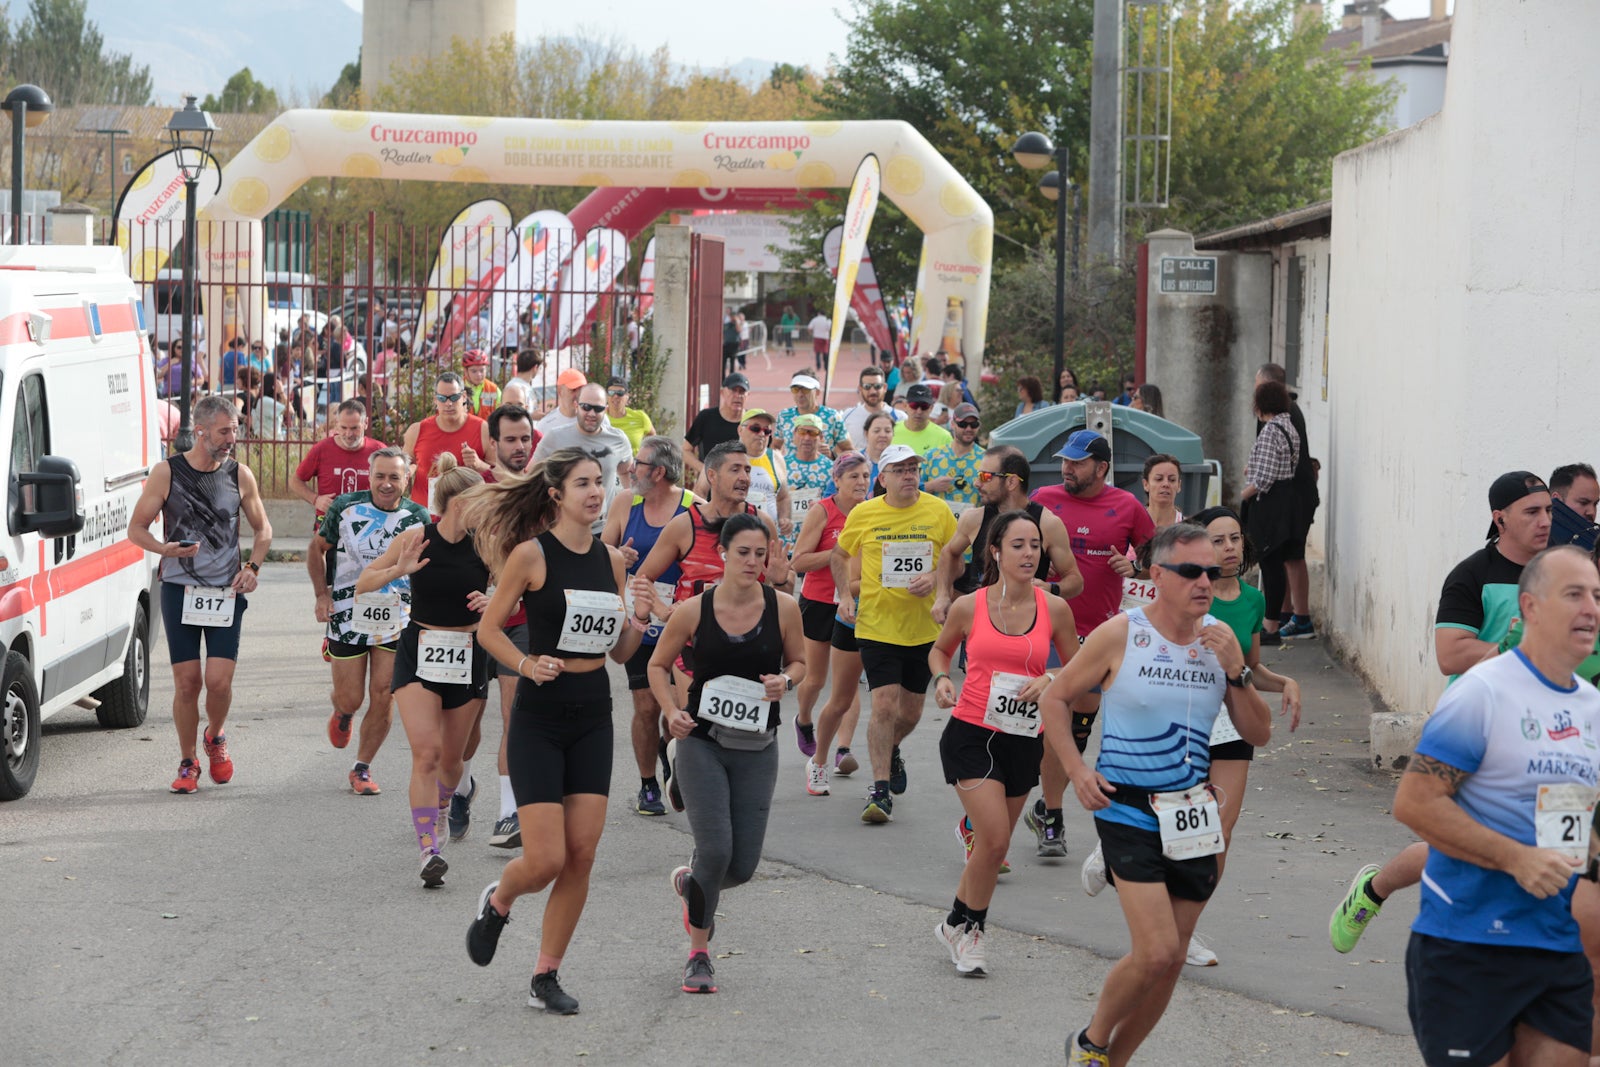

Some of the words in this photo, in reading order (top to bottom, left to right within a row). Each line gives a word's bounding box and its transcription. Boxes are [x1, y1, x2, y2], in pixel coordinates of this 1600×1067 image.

[370, 124, 478, 147] Cruzcampo
[565, 137, 616, 152] NATURAL
[619, 138, 635, 152] DE
[703, 132, 811, 152] Cruzcampo
[380, 147, 433, 166] Radler
[504, 152, 585, 168] DOBLEMENTE
[587, 153, 673, 169] REFRESCANTE
[713, 154, 766, 173] Radler
[1179, 260, 1210, 270] CALLE
[794, 499, 814, 511] 78
[894, 557, 923, 572] 256
[195, 597, 225, 611] 817
[363, 607, 390, 621] 466
[570, 613, 616, 636] 3043
[424, 646, 466, 664] 2214
[1138, 665, 1216, 684] MARACENA
[708, 696, 760, 724] 3094
[995, 695, 1039, 719] 3042
[1175, 805, 1209, 832] 861
